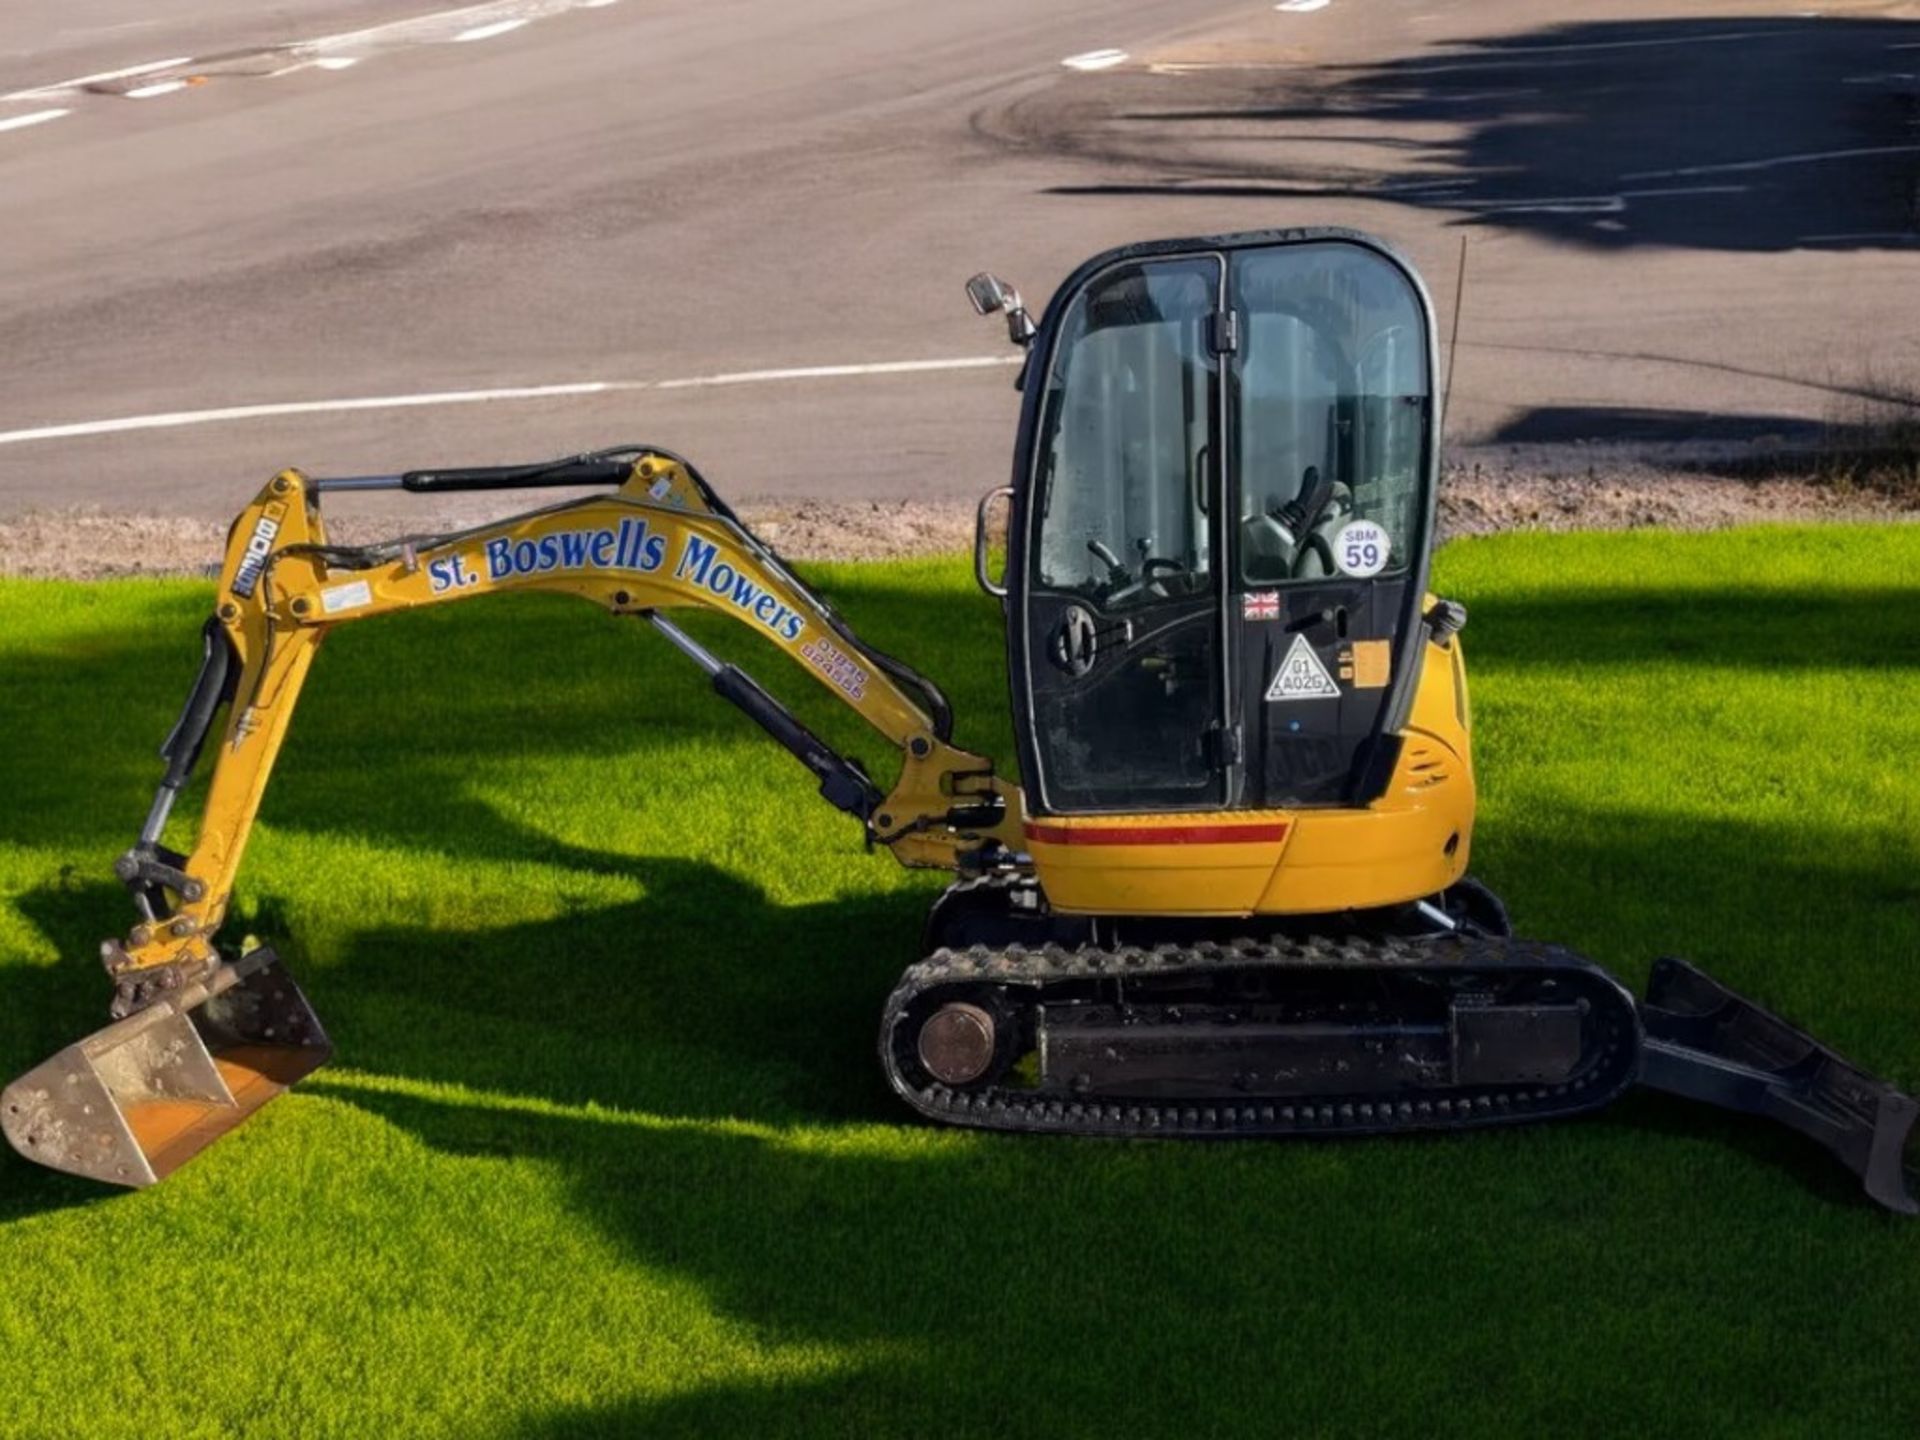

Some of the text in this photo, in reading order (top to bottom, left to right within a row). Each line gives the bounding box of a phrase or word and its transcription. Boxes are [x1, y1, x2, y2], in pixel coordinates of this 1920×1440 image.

[1345, 529, 1378, 542] SBM
[1346, 543, 1378, 568] 59
[428, 517, 805, 640] St. Boswells Mowers
